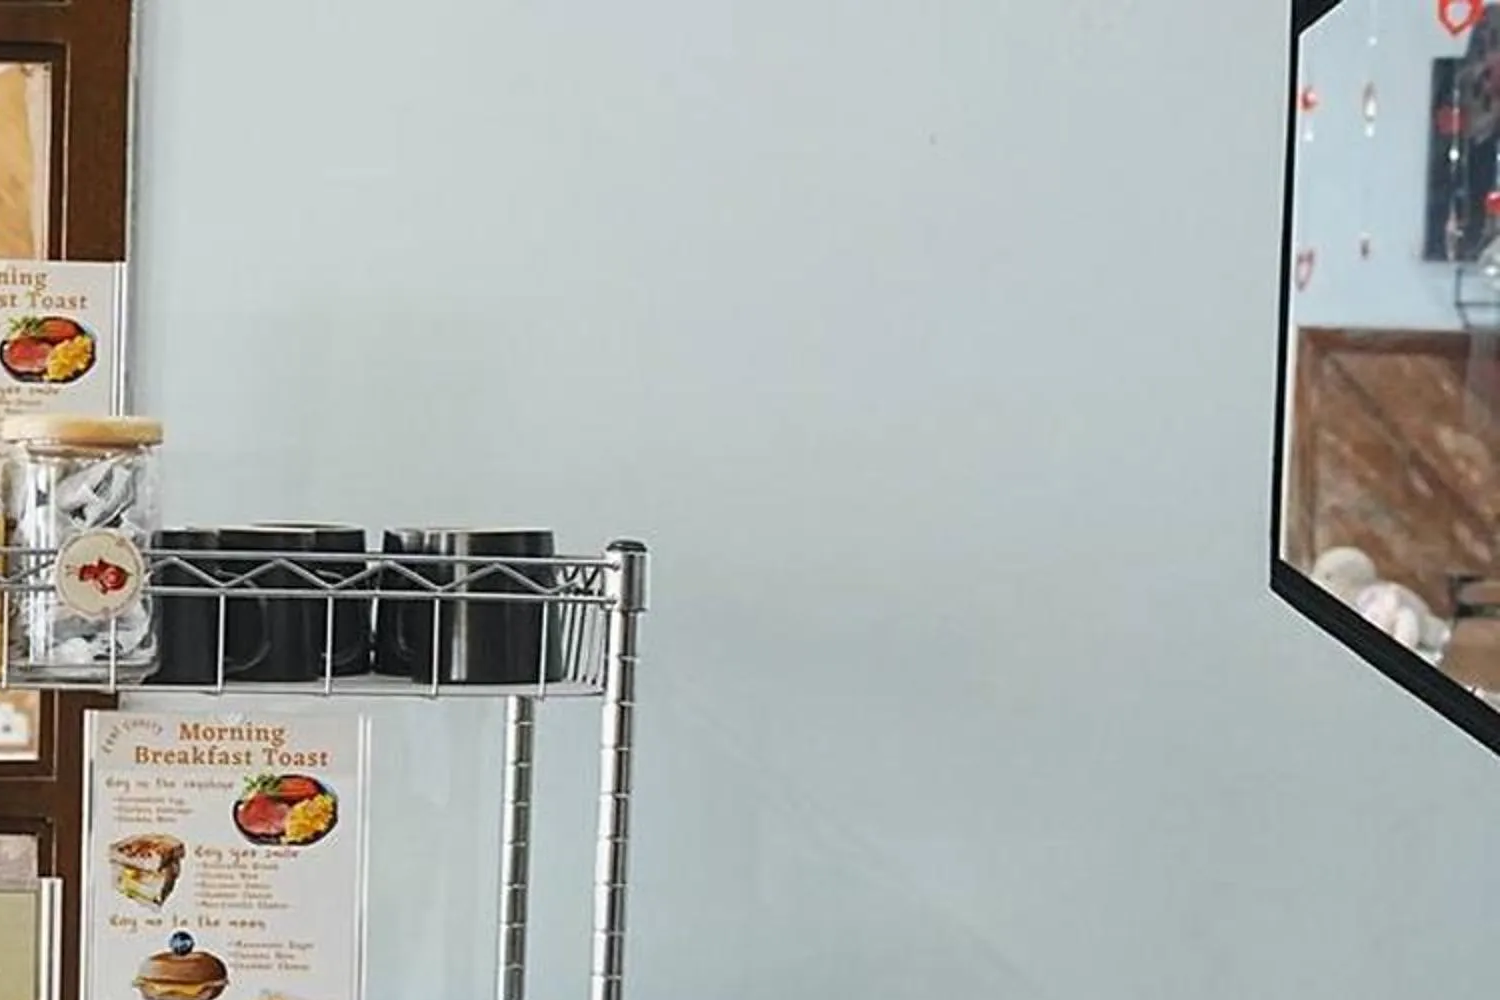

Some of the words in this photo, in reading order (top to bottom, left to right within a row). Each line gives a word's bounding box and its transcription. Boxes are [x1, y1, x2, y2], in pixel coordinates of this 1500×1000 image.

[26, 289, 89, 310] Toast
[179, 722, 286, 746] Morning
[135, 745, 252, 766] Breakfast
[262, 748, 329, 768] Toast
